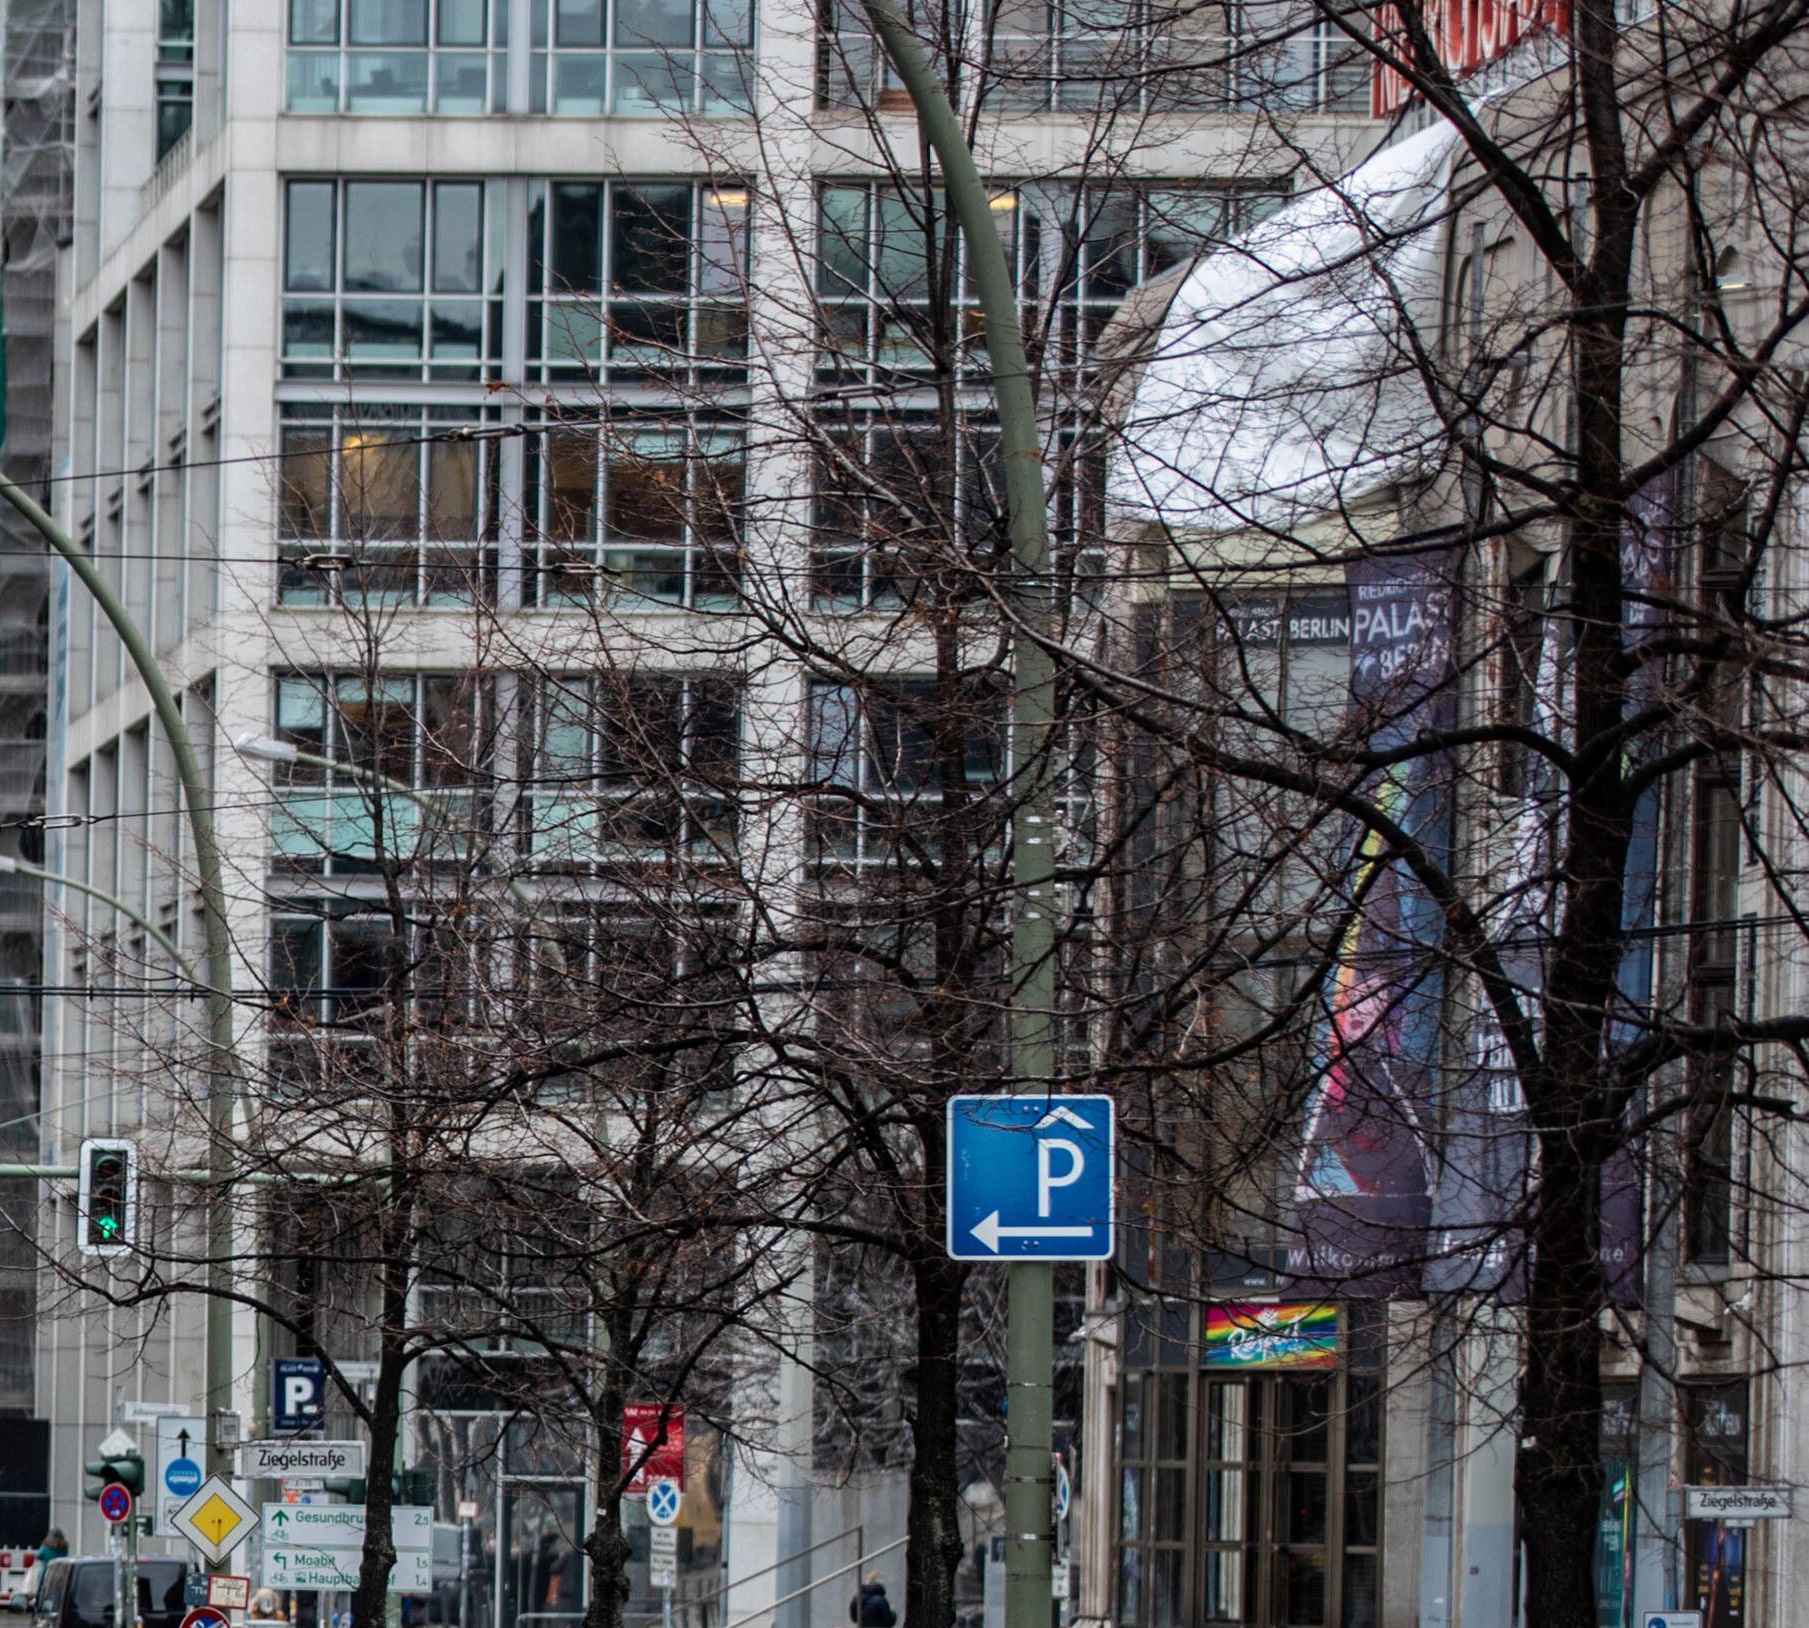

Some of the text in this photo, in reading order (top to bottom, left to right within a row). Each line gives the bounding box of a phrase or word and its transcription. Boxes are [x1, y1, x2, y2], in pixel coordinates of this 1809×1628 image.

[1289, 617, 1351, 640] BERLIN
[1038, 1138, 1085, 1217] P
[258, 1449, 346, 1471] Ziegelstraße
[1699, 1492, 1777, 1511] Ziegelstraße
[294, 1553, 336, 1567] Moabit
